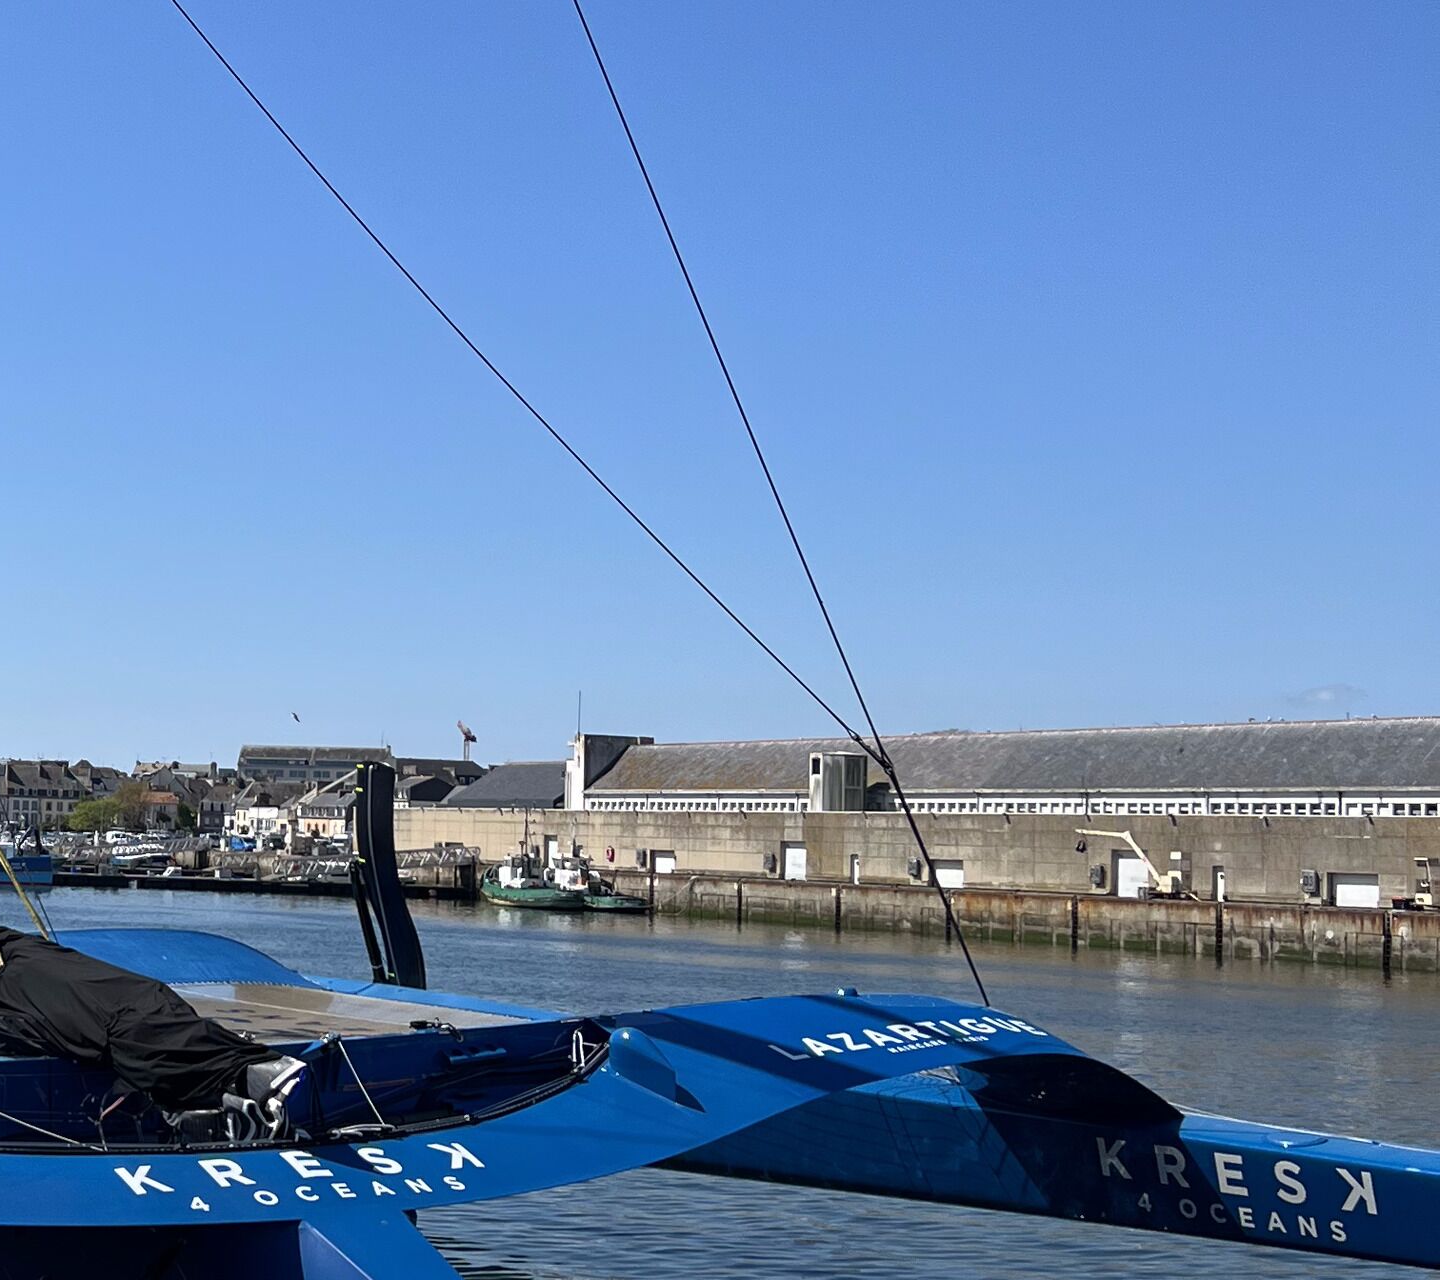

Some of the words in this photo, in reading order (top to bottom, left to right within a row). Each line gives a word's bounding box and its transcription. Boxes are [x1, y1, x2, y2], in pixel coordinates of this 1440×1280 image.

[768, 1016, 1049, 1061] LAZARTIGUE
[114, 1142, 485, 1195] KRESK
[190, 1196, 210, 1211] 4
[253, 1175, 466, 1206] OCEANS
[1096, 1137, 1378, 1215] KRESK
[1137, 1192, 1152, 1212] 4
[1179, 1199, 1347, 1242] OCEANS
